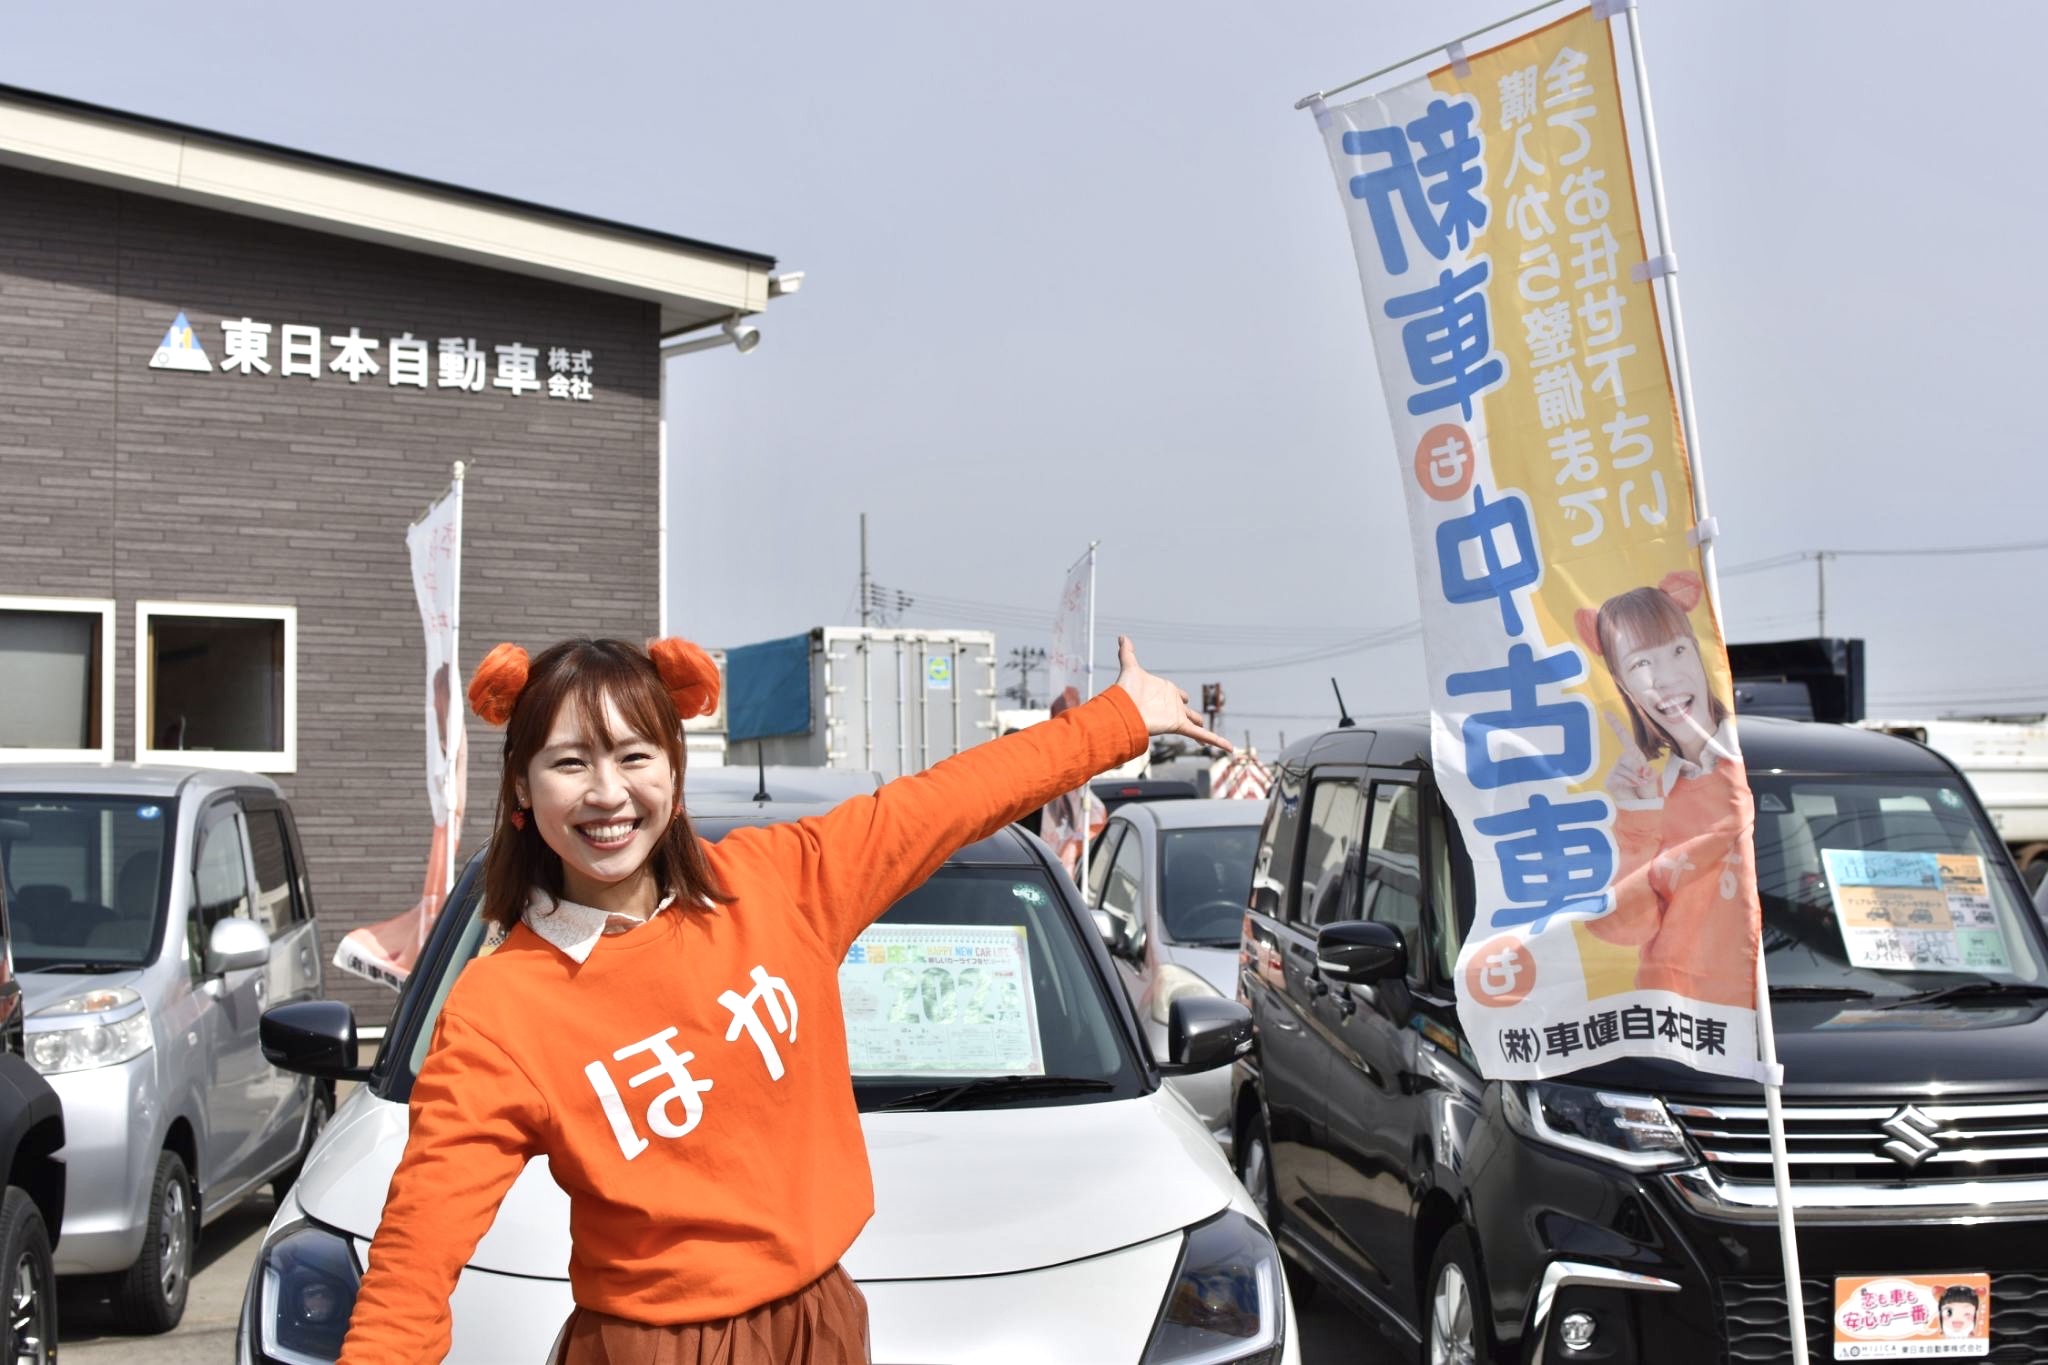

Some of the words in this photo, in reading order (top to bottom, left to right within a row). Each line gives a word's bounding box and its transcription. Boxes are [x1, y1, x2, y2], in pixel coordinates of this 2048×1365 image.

[220, 317, 541, 397] 東日本自動車
[584, 965, 798, 1160] ほや
[1843, 1305, 1928, 1330] 安心が一番
